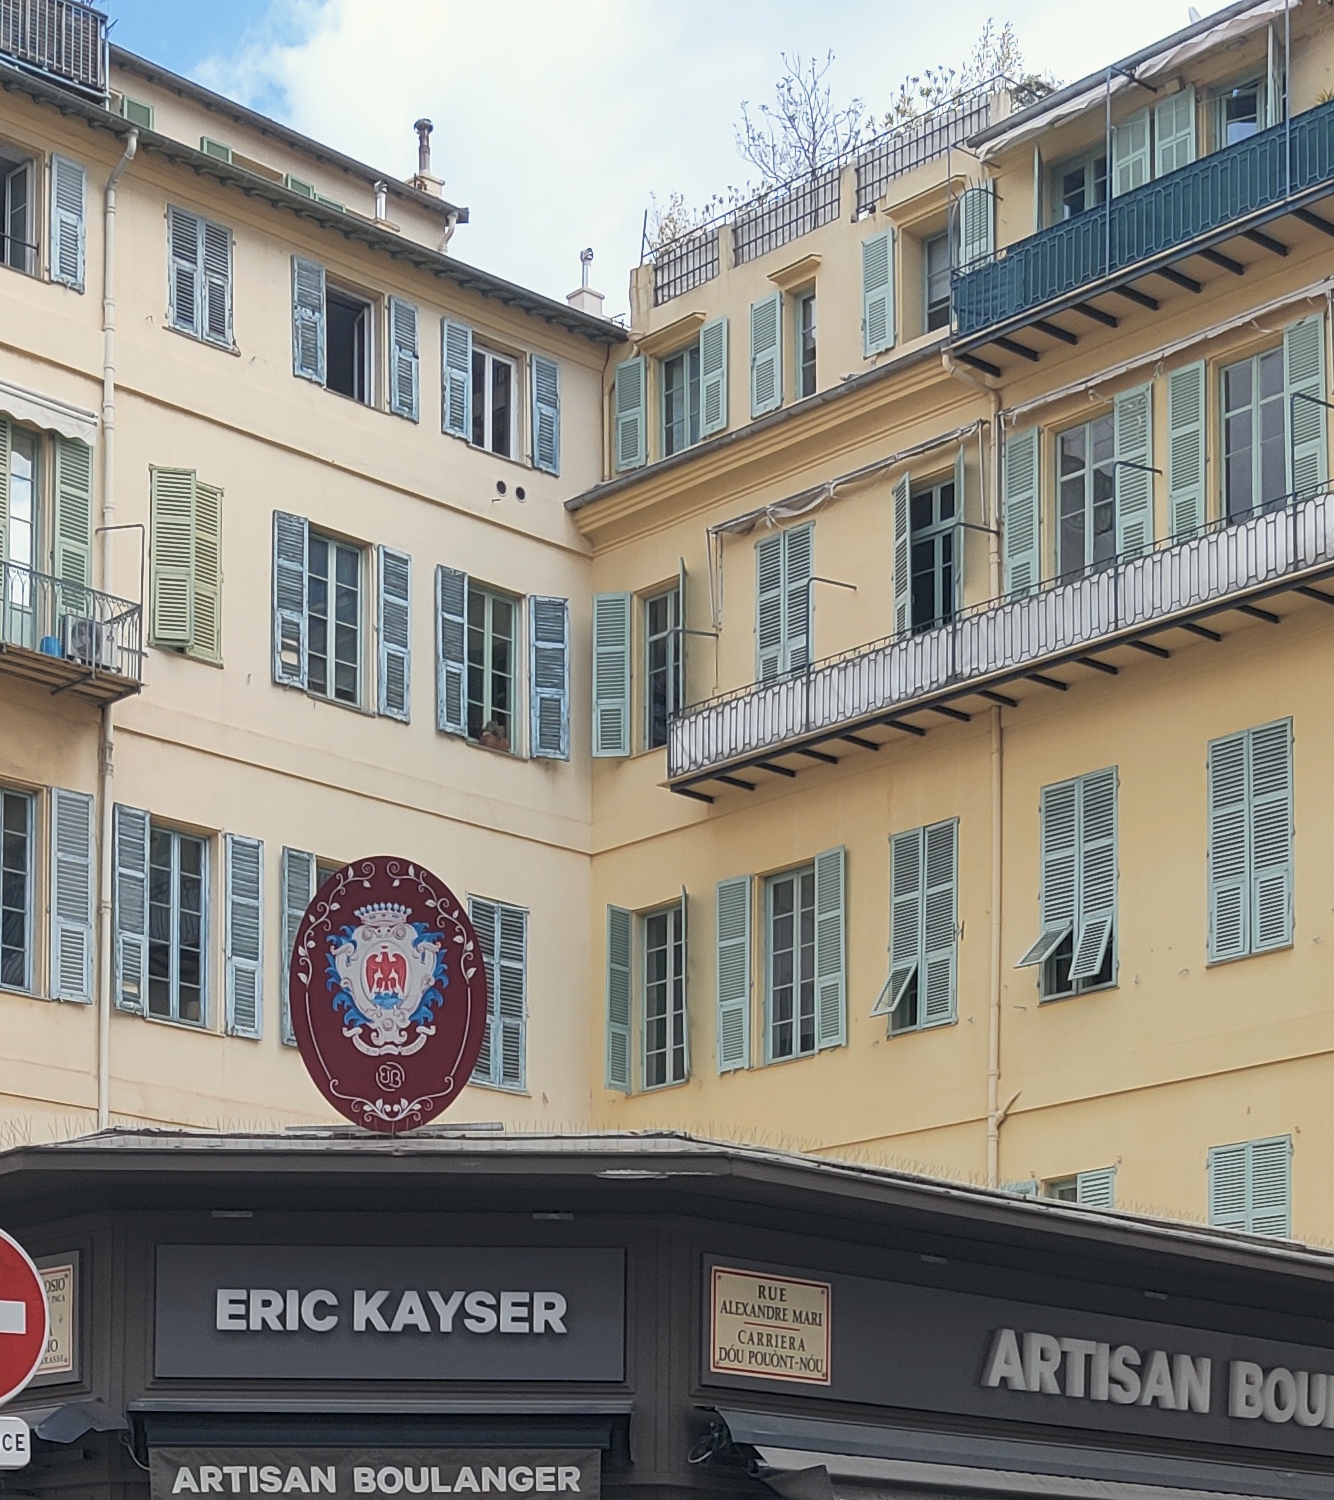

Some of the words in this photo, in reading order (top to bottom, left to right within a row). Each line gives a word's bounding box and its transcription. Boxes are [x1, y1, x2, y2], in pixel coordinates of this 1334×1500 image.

[44, 1277, 65, 1293] OSIO
[758, 1285, 787, 1302] RUE
[216, 1289, 339, 1332] ERIC
[353, 1290, 567, 1334] KAYSER
[720, 1300, 788, 1322] ALEXANDRE
[792, 1309, 822, 1327] MARI
[738, 1329, 806, 1352] CARRIERA
[981, 1328, 1212, 1413] ARTISAN
[171, 1466, 337, 1493] ARTISAN
[354, 1466, 581, 1493] BOULANGER
